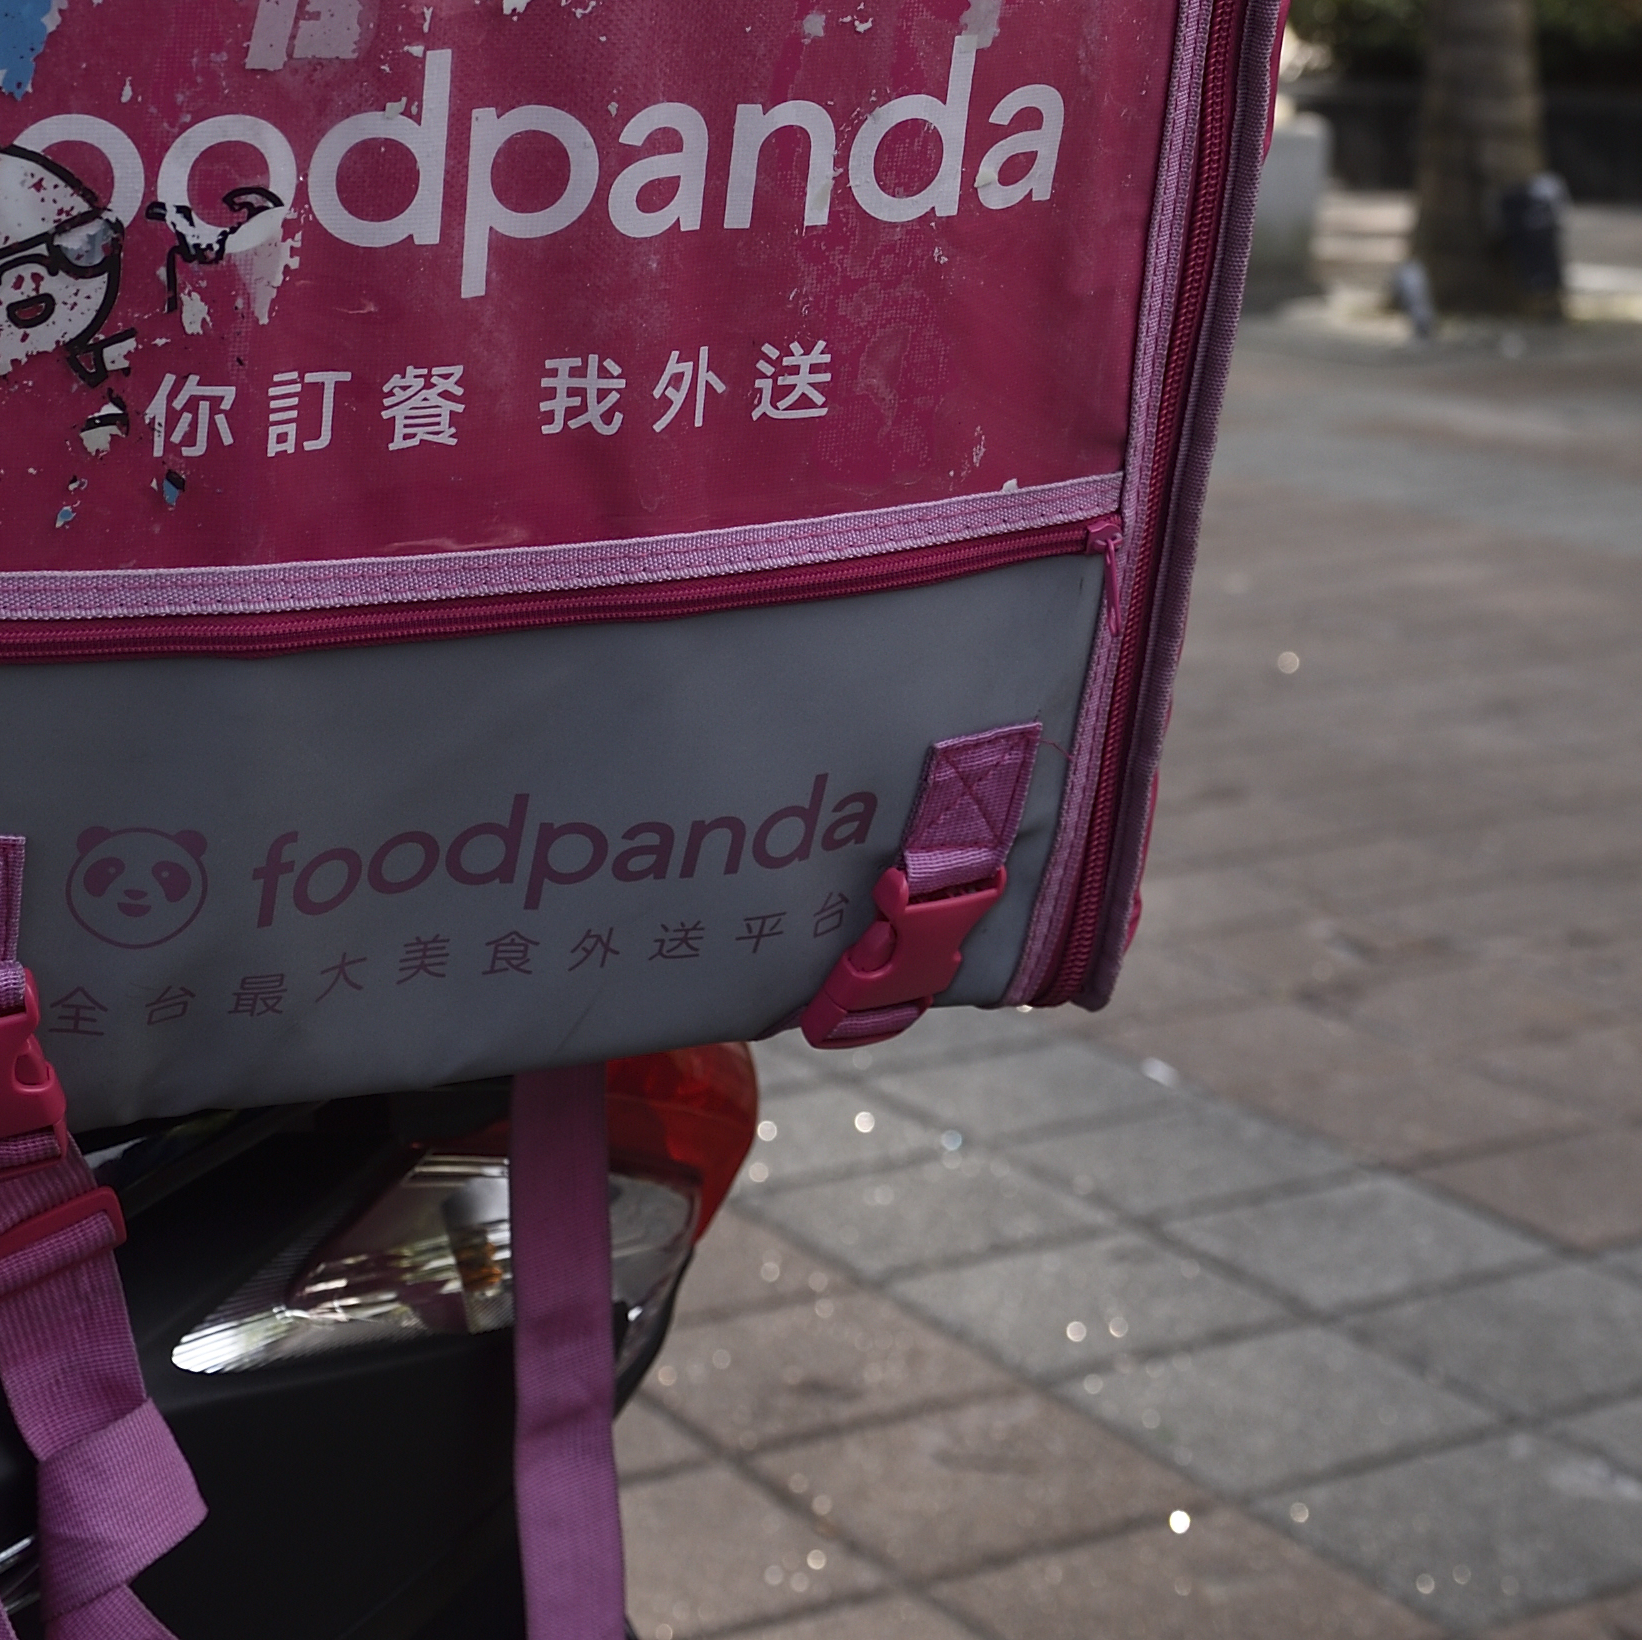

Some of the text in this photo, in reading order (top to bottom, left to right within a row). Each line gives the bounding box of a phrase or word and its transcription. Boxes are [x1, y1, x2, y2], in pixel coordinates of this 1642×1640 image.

[145, 339, 834, 459] 你訂餐 我外送
[251, 772, 879, 930] foodpanda
[47, 891, 851, 1038] 全台最大美食外送平台
